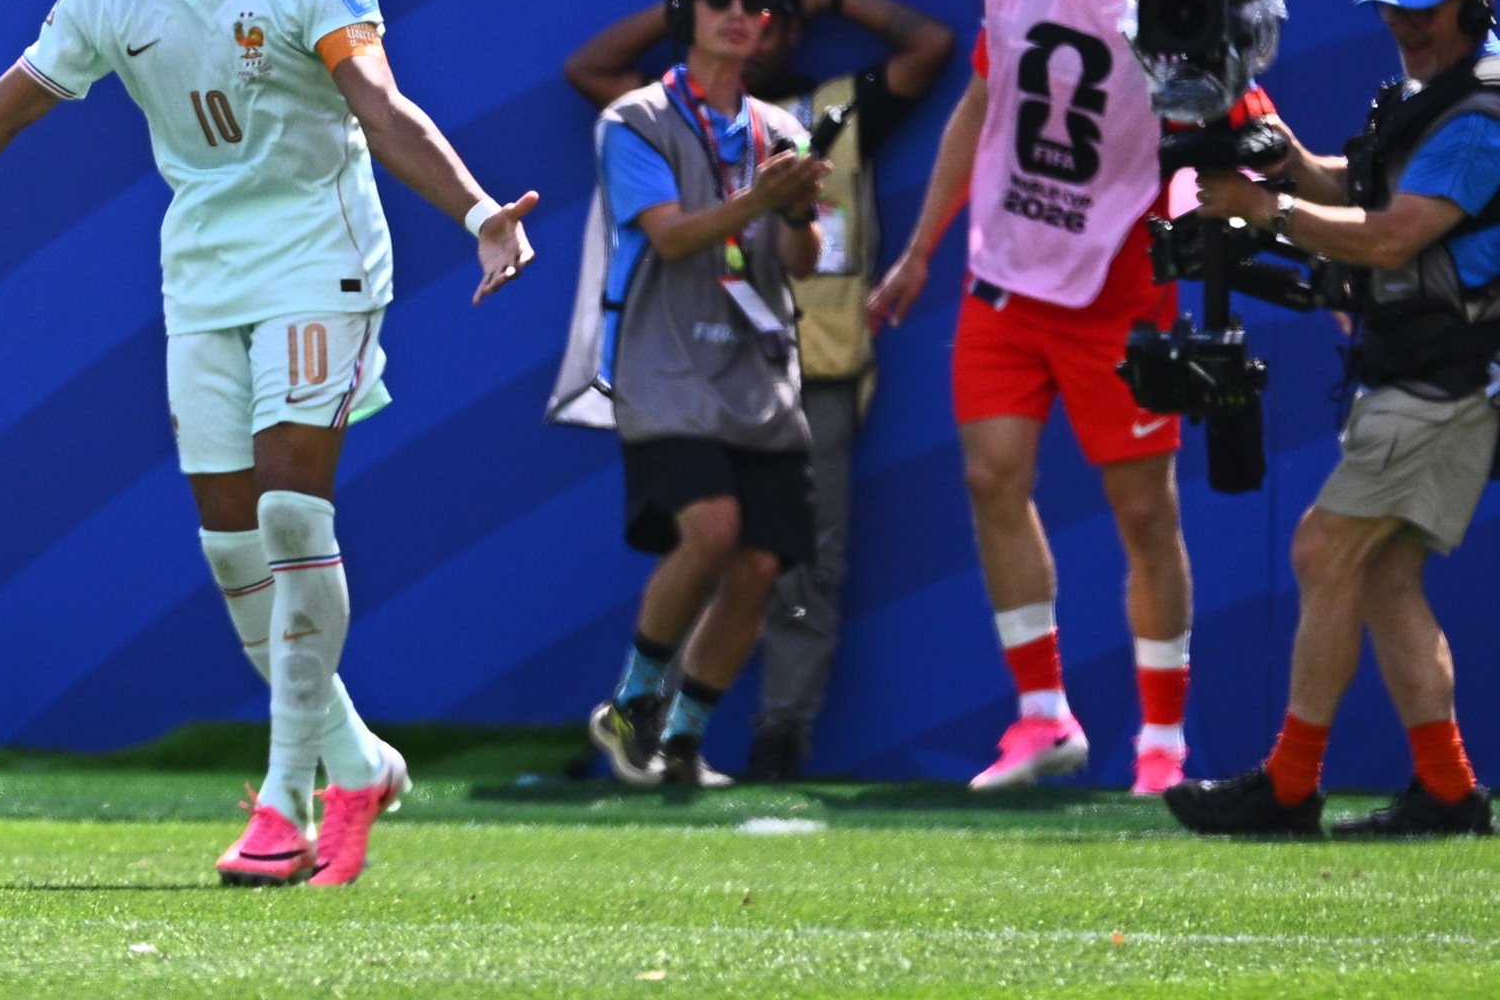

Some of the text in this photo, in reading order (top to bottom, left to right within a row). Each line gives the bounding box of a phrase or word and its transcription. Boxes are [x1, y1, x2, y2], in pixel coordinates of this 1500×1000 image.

[190, 90, 243, 146] 10
[1004, 190, 1087, 233] 2026
[288, 323, 328, 386] 10
